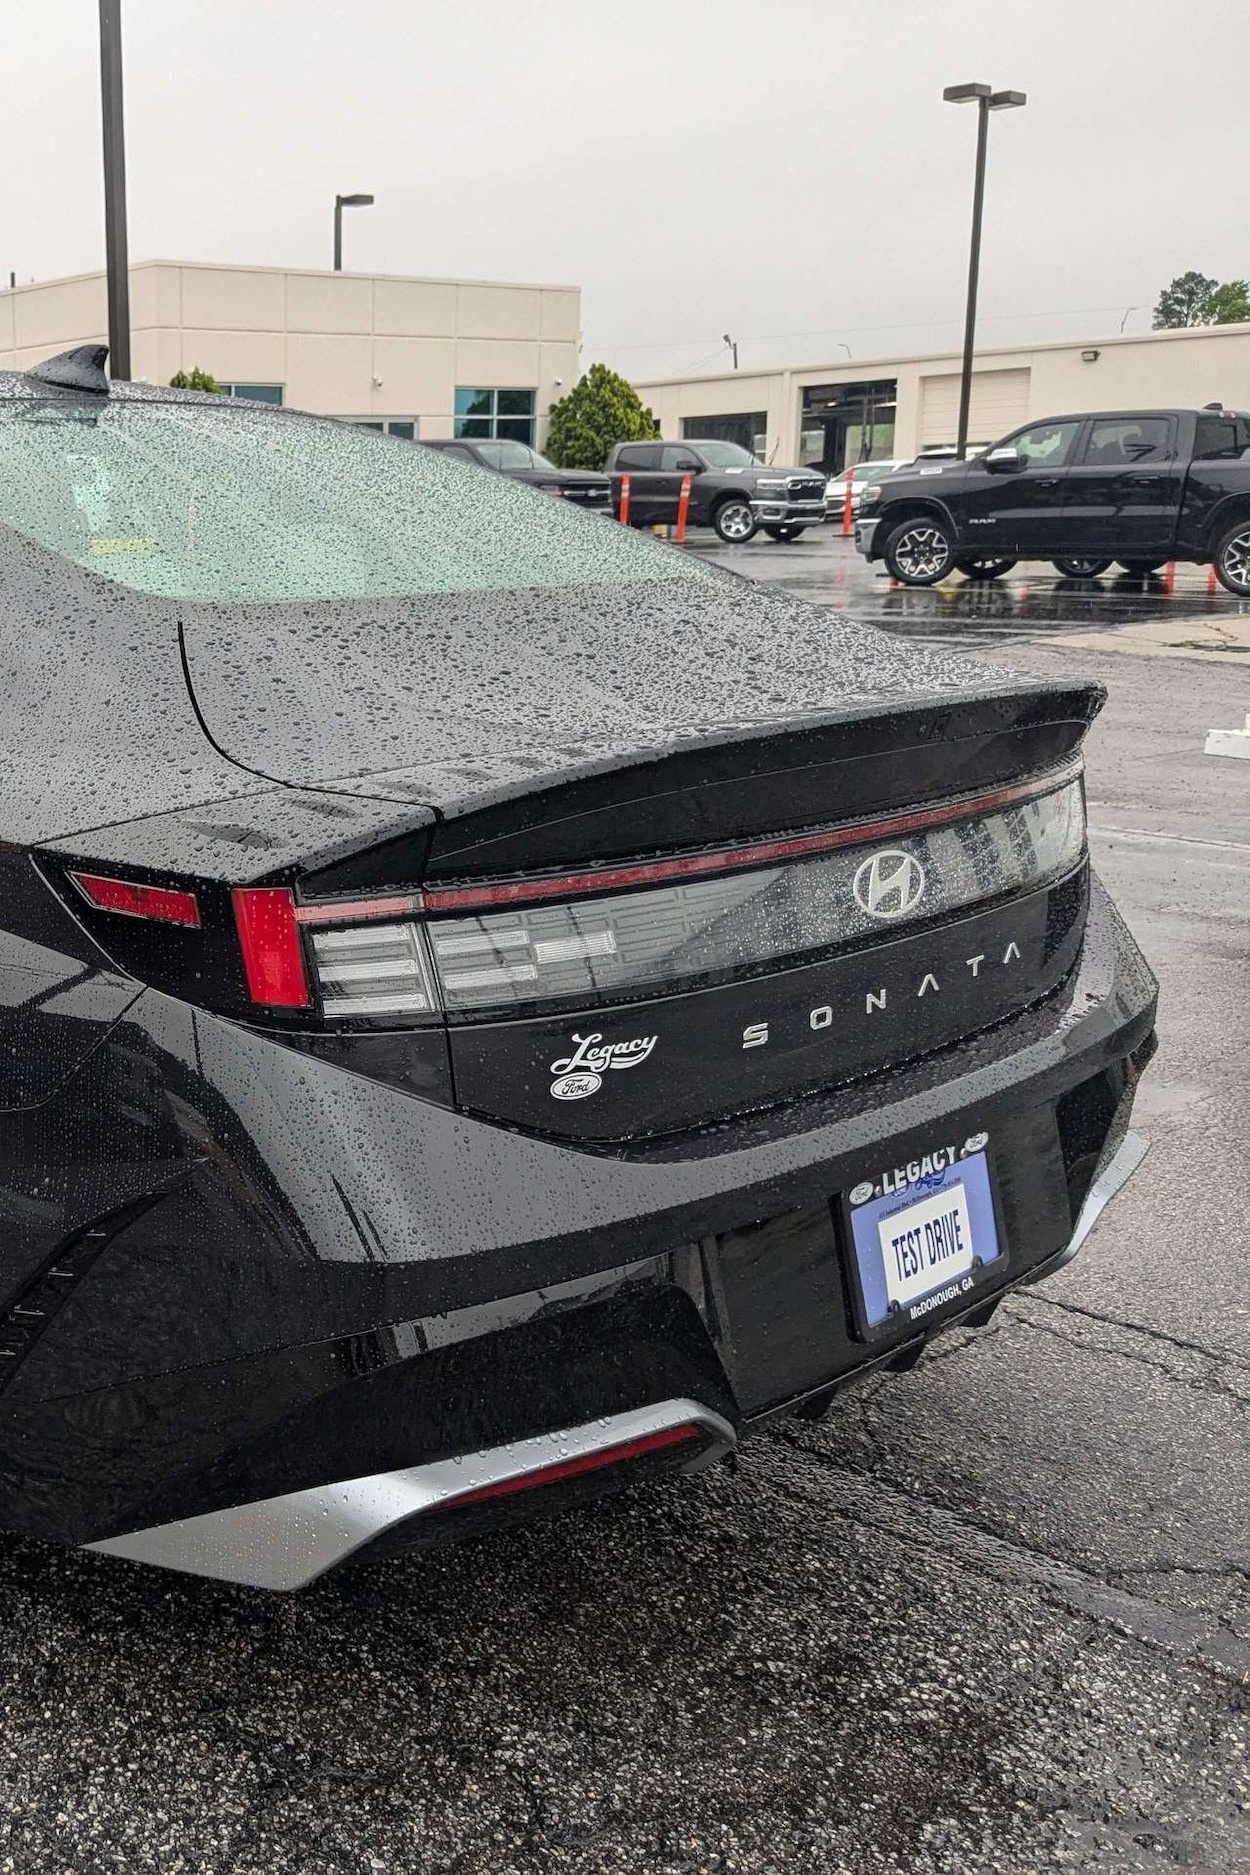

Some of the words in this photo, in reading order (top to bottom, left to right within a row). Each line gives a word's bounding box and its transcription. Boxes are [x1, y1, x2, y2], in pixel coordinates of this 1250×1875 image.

[741, 941, 1022, 1049] SONATA
[550, 1033, 659, 1075] Legacy
[881, 1146, 956, 1195] LEGACY
[891, 1226, 925, 1282] TEST
[924, 1208, 964, 1267] DRIVE
[909, 1285, 962, 1320] McDONOUGH,
[961, 1276, 975, 1290] GA
